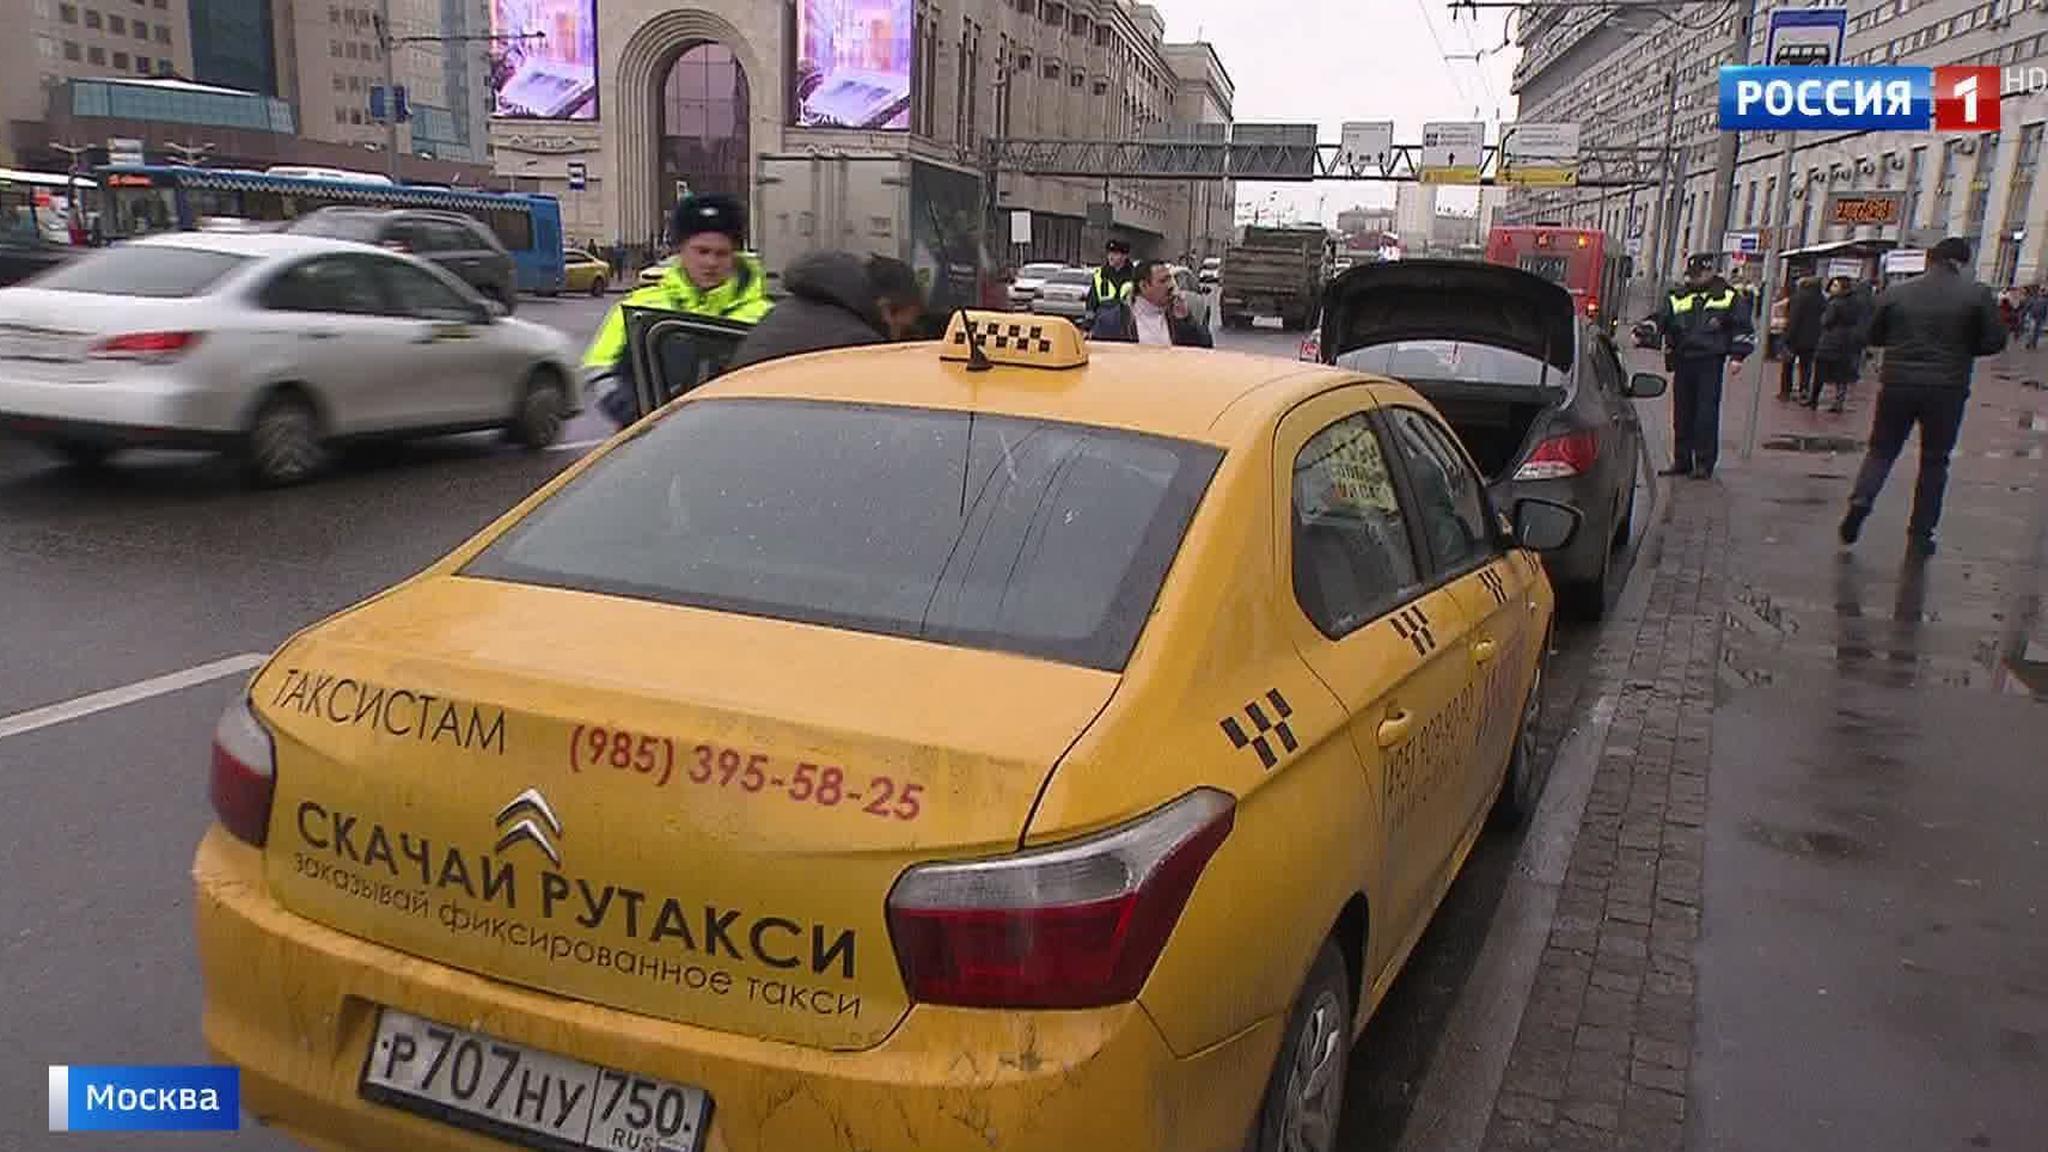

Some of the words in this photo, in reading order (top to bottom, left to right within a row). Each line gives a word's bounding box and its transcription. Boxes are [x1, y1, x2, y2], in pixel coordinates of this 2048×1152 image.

[272, 668, 506, 756] ТАКСИСТАМ
[569, 723, 675, 787] (985)
[688, 743, 925, 822] 395-58-25
[293, 851, 430, 920] заказывай
[438, 899, 733, 994] фиксированное
[747, 976, 862, 1019] такси
[540, 870, 857, 980] РУТАКСИ
[601, 1071, 686, 1138] 750
